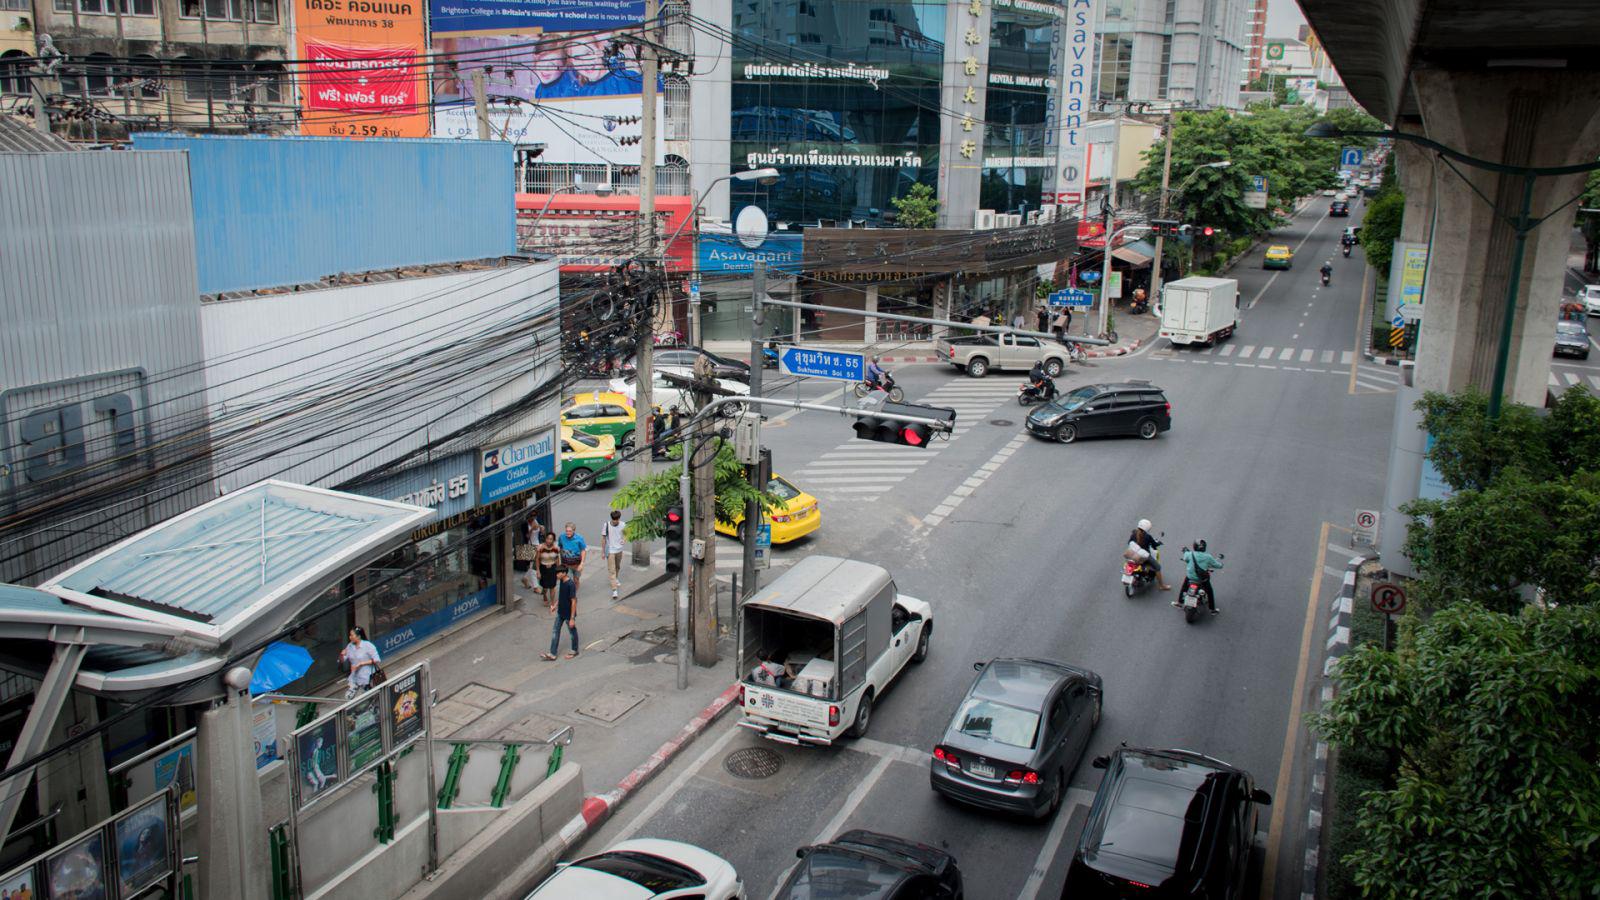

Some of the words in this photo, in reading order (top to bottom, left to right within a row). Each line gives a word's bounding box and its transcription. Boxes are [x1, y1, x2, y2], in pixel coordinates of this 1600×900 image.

[440, 6, 469, 16] Brighton
[470, 7, 494, 17] College
[501, 8, 531, 17] Britain's
[531, 9, 558, 18] number
[564, 11, 587, 19] school
[381, 19, 394, 28] 38
[1066, 0, 1091, 146] Asavanant
[344, 90, 376, 104] เฟอร์
[328, 121, 345, 135] เริ่ม
[348, 124, 378, 136] 2.59
[708, 248, 793, 262] Asavanant
[795, 351, 831, 366] สุขุมวิท
[845, 357, 859, 369] 55
[797, 365, 828, 375] Sukhumvit
[831, 369, 843, 377] Soi
[501, 437, 552, 466] Charmant
[448, 474, 469, 499] 55
[453, 597, 480, 616] HOYA
[385, 628, 414, 649] HOYA
[394, 674, 417, 693] QUEEN
